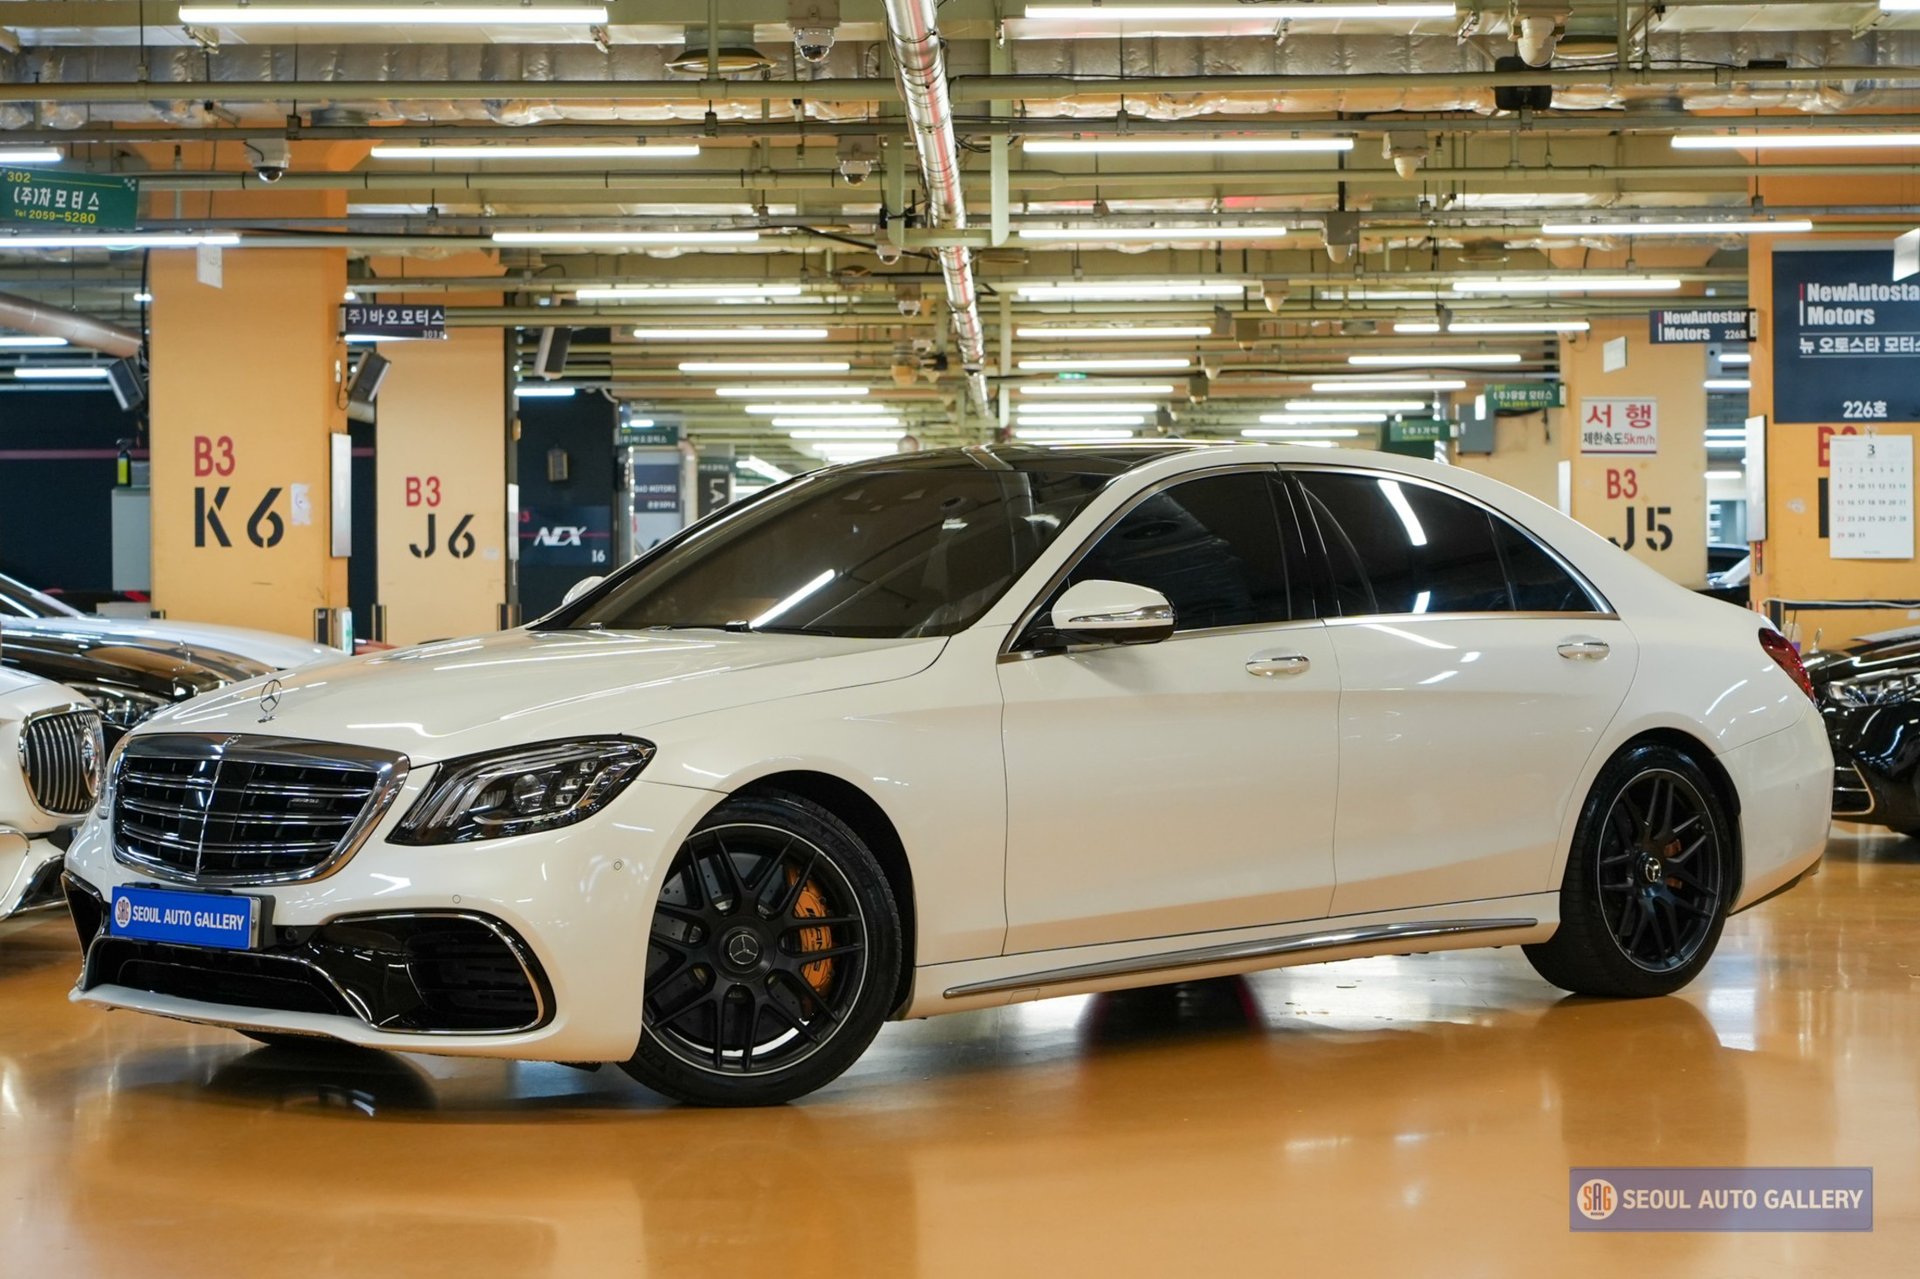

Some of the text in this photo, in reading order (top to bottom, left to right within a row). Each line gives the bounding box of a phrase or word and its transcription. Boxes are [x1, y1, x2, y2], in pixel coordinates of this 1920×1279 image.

[7, 171, 31, 183] 302
[29, 210, 96, 224] 2059-5280
[1663, 310, 1747, 325] NewAutostar
[1807, 306, 1875, 325] Motors
[1664, 327, 1711, 341] Motors
[1800, 337, 1815, 354] 뉴
[1819, 337, 1881, 353] 오토스타
[1843, 400, 1887, 418] 226호
[194, 436, 235, 477] B3
[1868, 444, 1875, 456] 3
[406, 476, 441, 507] B3
[1607, 469, 1638, 499] B3
[132, 905, 245, 931] SEOUL AUTO GALLERY
